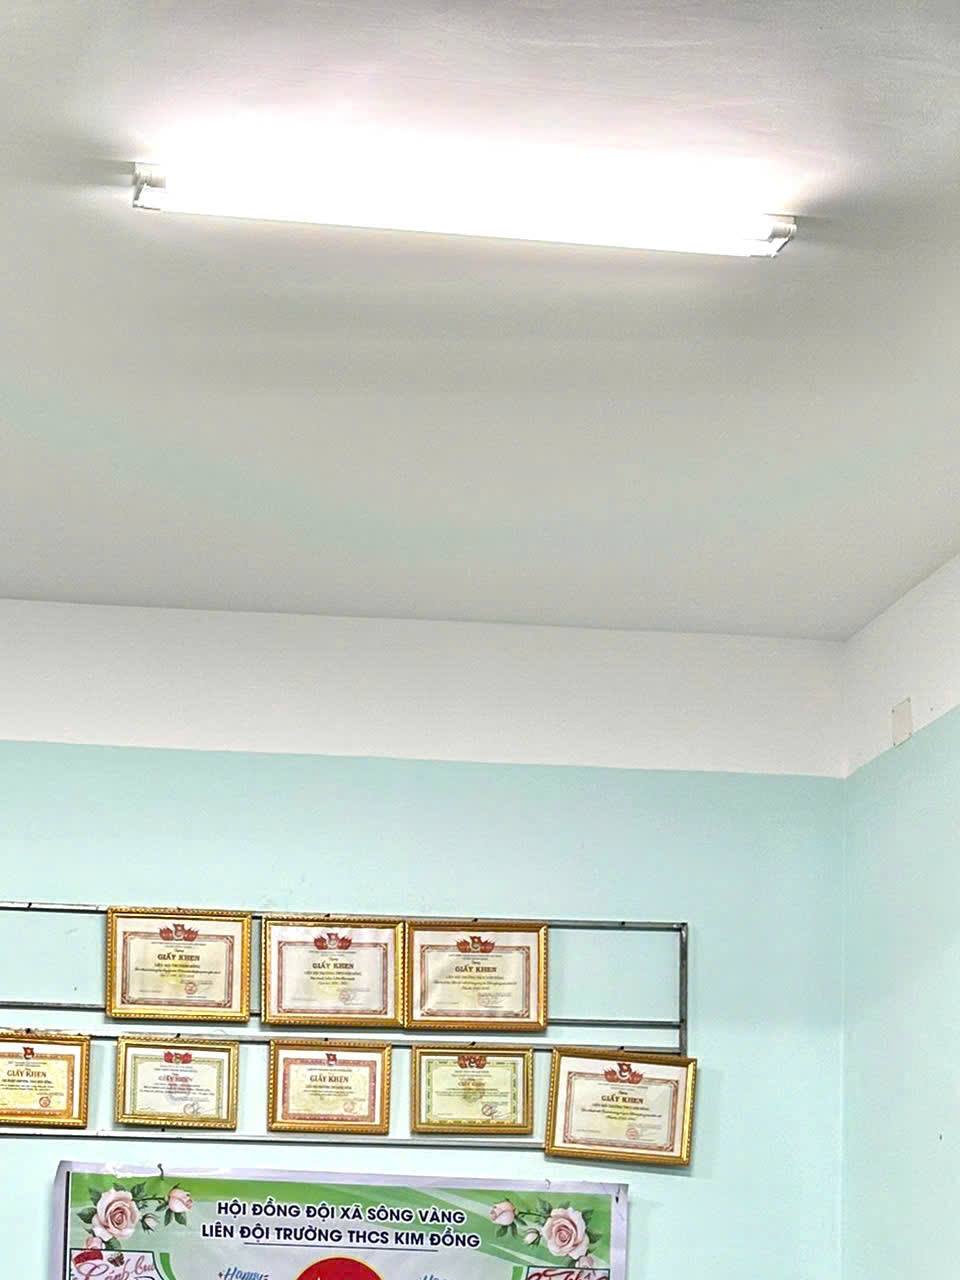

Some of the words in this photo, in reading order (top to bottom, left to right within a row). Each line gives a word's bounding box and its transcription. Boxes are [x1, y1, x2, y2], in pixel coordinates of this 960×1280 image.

[217, 1199, 246, 1218] HỘI
[251, 1197, 301, 1217] ĐỒNG
[305, 1203, 335, 1221] ĐỘI
[340, 1204, 363, 1220] XÃ
[367, 1206, 413, 1221] SÔNG
[418, 1208, 465, 1223] VÀNG
[202, 1221, 234, 1238] LIÊN
[239, 1223, 270, 1242] ĐỘI
[274, 1225, 343, 1242] TRƯỜNG
[347, 1231, 389, 1244] THCS
[395, 1232, 424, 1245] KIM
[429, 1227, 480, 1247] ĐỒNG
